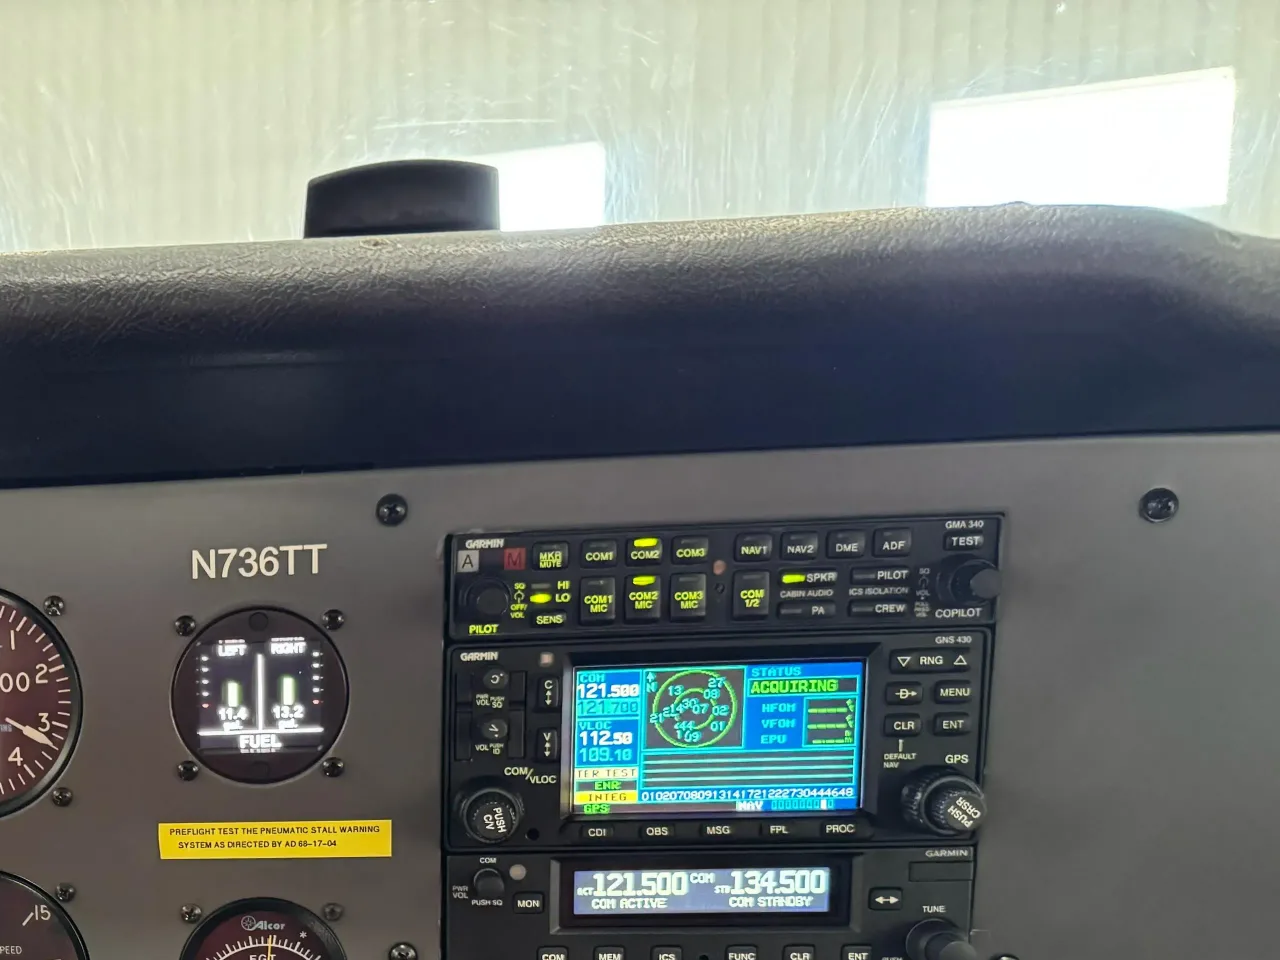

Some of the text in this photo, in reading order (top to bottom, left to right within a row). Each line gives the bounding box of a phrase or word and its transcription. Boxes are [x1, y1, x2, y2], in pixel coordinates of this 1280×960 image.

[945, 520, 984, 529] GMA 340
[465, 538, 505, 549] GARMIN
[883, 541, 906, 551] ADF
[952, 537, 980, 546] TEST
[741, 546, 768, 555] NAV1
[787, 545, 814, 554] NAV2
[836, 543, 858, 552] DME
[539, 552, 563, 561] MKR
[585, 552, 614, 561] COM1
[631, 550, 659, 559] COM2
[676, 548, 705, 558] COM3
[191, 544, 327, 579] N736TT
[462, 554, 474, 568] A
[508, 552, 520, 566] M
[539, 560, 562, 569] MUTE
[806, 572, 837, 582] SPKR
[780, 588, 833, 598] CABIN AUDIO
[875, 604, 906, 613] CREW
[935, 608, 982, 619] COPILOT
[536, 615, 563, 625] SENS
[469, 624, 499, 634] PILOT
[935, 636, 955, 644] GNS
[218, 644, 247, 656] LEFT
[270, 642, 306, 654] RIGHT
[460, 652, 498, 661] GARMIN
[920, 656, 943, 665] RNG
[752, 667, 801, 676] STATUS
[578, 683, 639, 698] 121.500
[750, 678, 838, 694] ACQUIRING
[940, 688, 970, 697] MENU
[273, 706, 304, 718] 13.2
[578, 701, 638, 714] 121.700
[218, 707, 248, 720] 11.4
[579, 721, 611, 730] VLOC
[894, 721, 915, 730] CLR
[942, 720, 964, 729] ENT
[240, 735, 282, 749] FUEL
[579, 731, 632, 746] 112.50
[579, 748, 632, 762] 109.10
[945, 755, 968, 764] GPS
[170, 828, 216, 836] PREFLIGHT
[242, 827, 258, 835] THE
[260, 826, 309, 835] PNEUMATIC
[310, 826, 337, 834] STALL
[340, 825, 380, 833] WARNING
[588, 827, 606, 837] CDI
[646, 826, 668, 836] OBS
[706, 825, 730, 835] MSG
[770, 825, 788, 834] FPL
[826, 824, 854, 834] PROC
[178, 840, 212, 849] SYSTEM
[214, 840, 226, 848] AS
[227, 840, 270, 848] DIRECTED
[271, 839, 283, 848] BY
[284, 839, 297, 848] AD
[925, 849, 968, 857] GARMIN
[592, 872, 688, 897] 121.500
[730, 870, 826, 894] 134.500
[517, 899, 540, 908] MON
[922, 905, 946, 913] TUNE
[251, 920, 285, 930] Alcor
